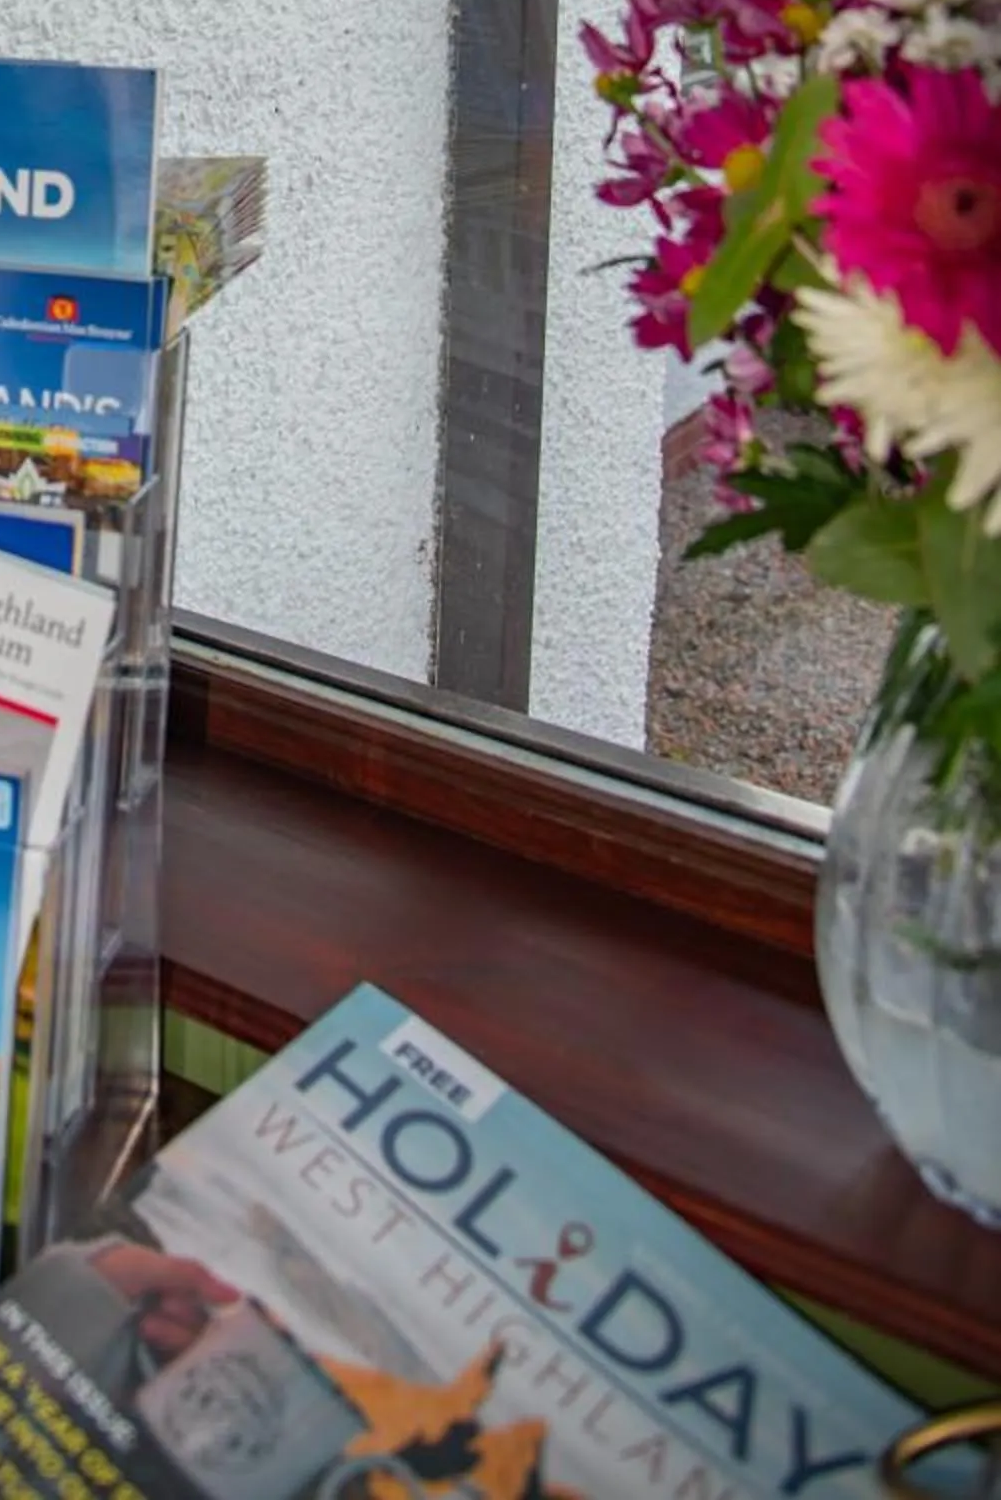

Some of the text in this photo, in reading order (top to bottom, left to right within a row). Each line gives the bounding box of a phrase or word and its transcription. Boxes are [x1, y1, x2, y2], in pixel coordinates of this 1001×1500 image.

[392, 1041, 476, 1106] FREE
[252, 1101, 417, 1246] WEST
[417, 1252, 734, 1500] HIGHLAN
[18, 1325, 73, 1380] THIS
